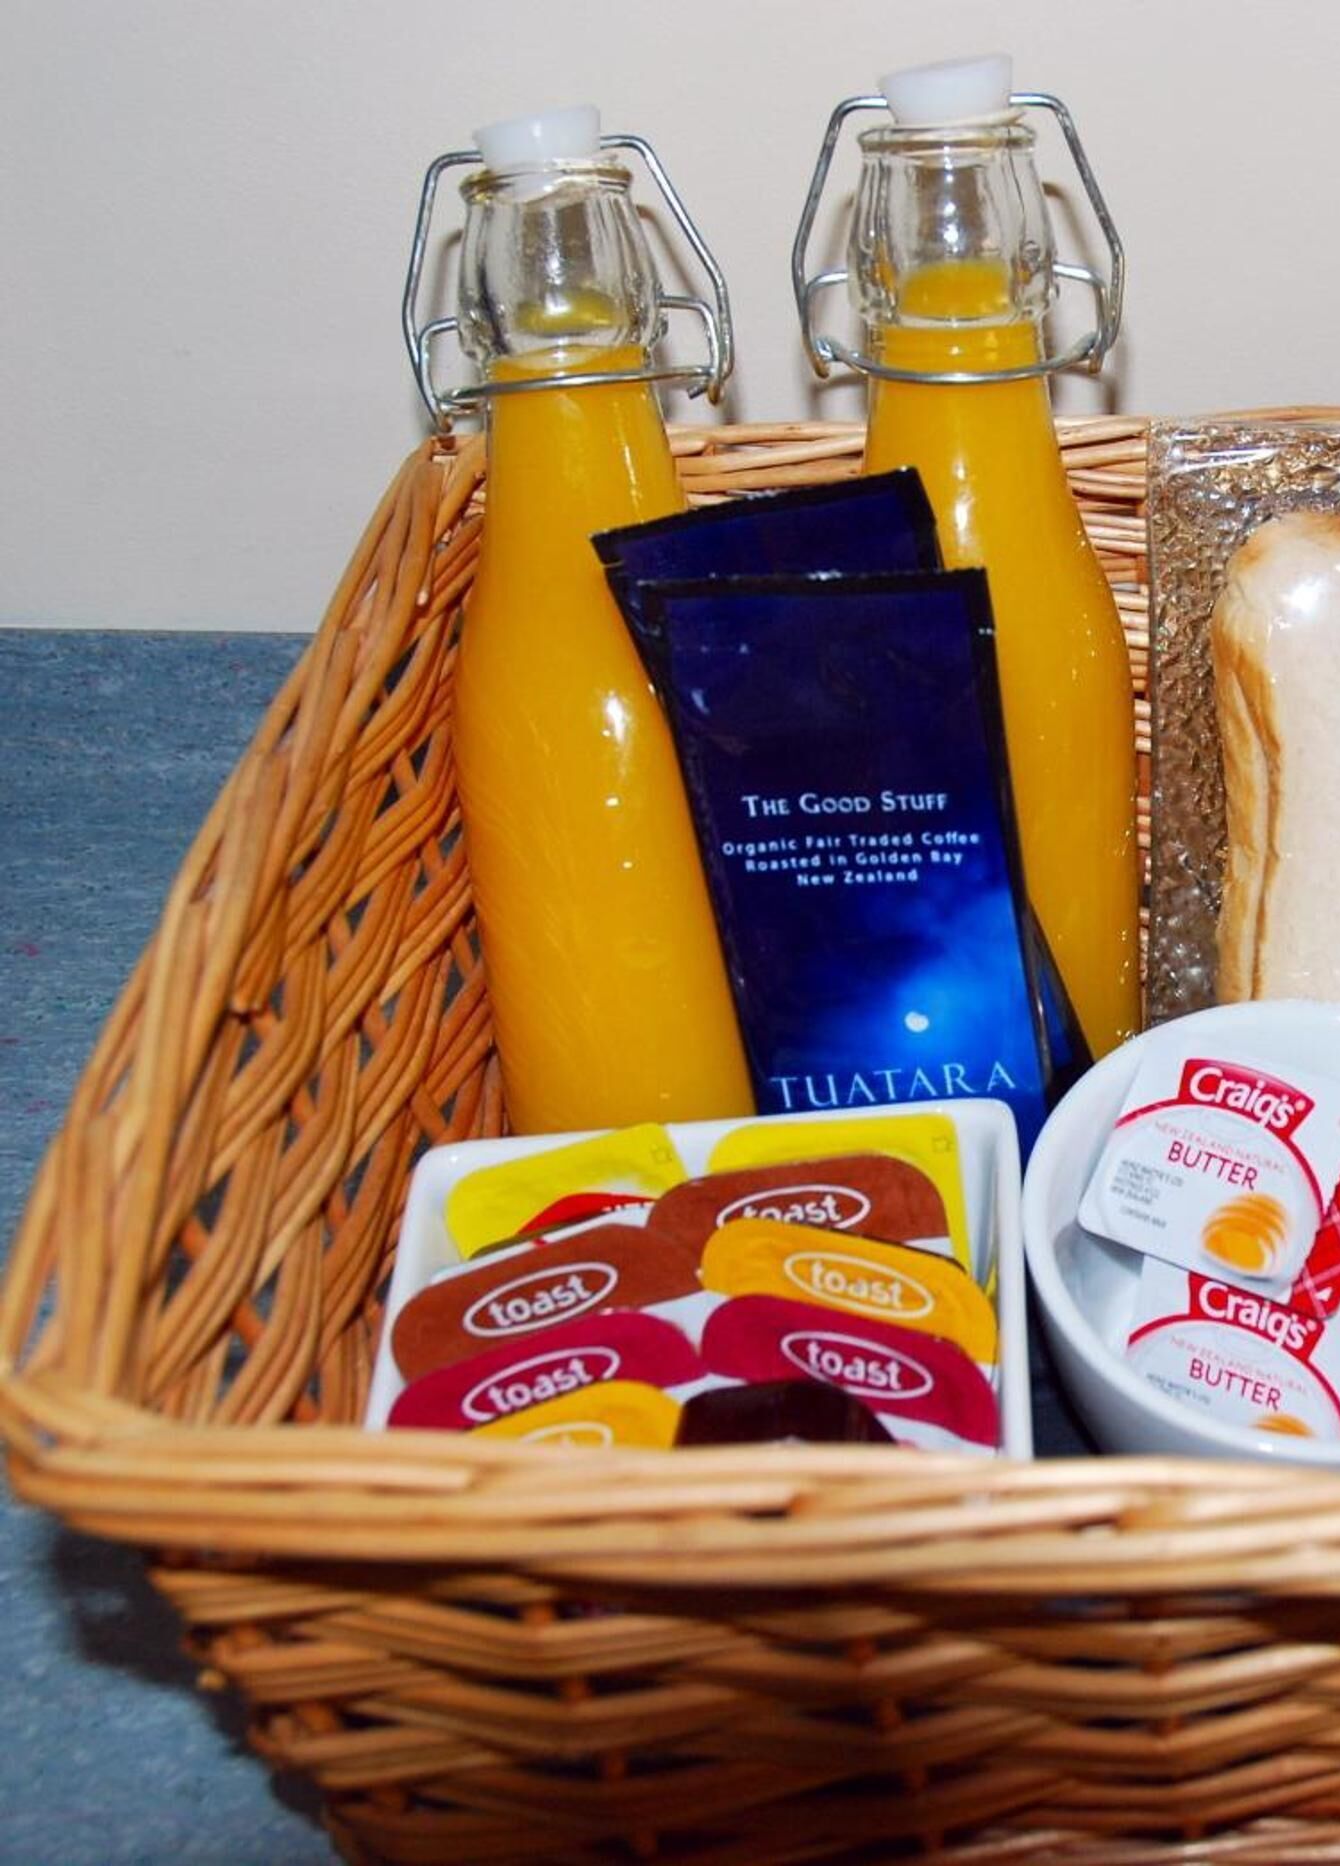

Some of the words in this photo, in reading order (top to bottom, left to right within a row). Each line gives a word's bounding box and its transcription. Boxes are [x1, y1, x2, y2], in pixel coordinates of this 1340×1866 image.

[742, 794, 790, 817] THE
[800, 793, 871, 814] GOOD
[881, 790, 948, 812] STUFF
[722, 838, 797, 856] Organic
[806, 835, 841, 848] Fair
[849, 832, 912, 847] Traded
[922, 831, 980, 845] Coffee
[745, 856, 821, 872] Roasted
[829, 853, 848, 866] in
[856, 852, 922, 866] Golden
[930, 850, 964, 865] Bay
[797, 873, 834, 887] New
[844, 868, 918, 884] Zealand
[769, 1060, 1017, 1109] TUATARA
[1189, 1066, 1296, 1128] Craig's
[1168, 1140, 1258, 1191] BUTTER
[488, 1274, 591, 1326] toast
[810, 1258, 904, 1308] toast
[1199, 1280, 1308, 1349] Craig's
[488, 1358, 592, 1412] toast
[807, 1340, 901, 1390] toast
[1189, 1357, 1282, 1411] BUTTER
